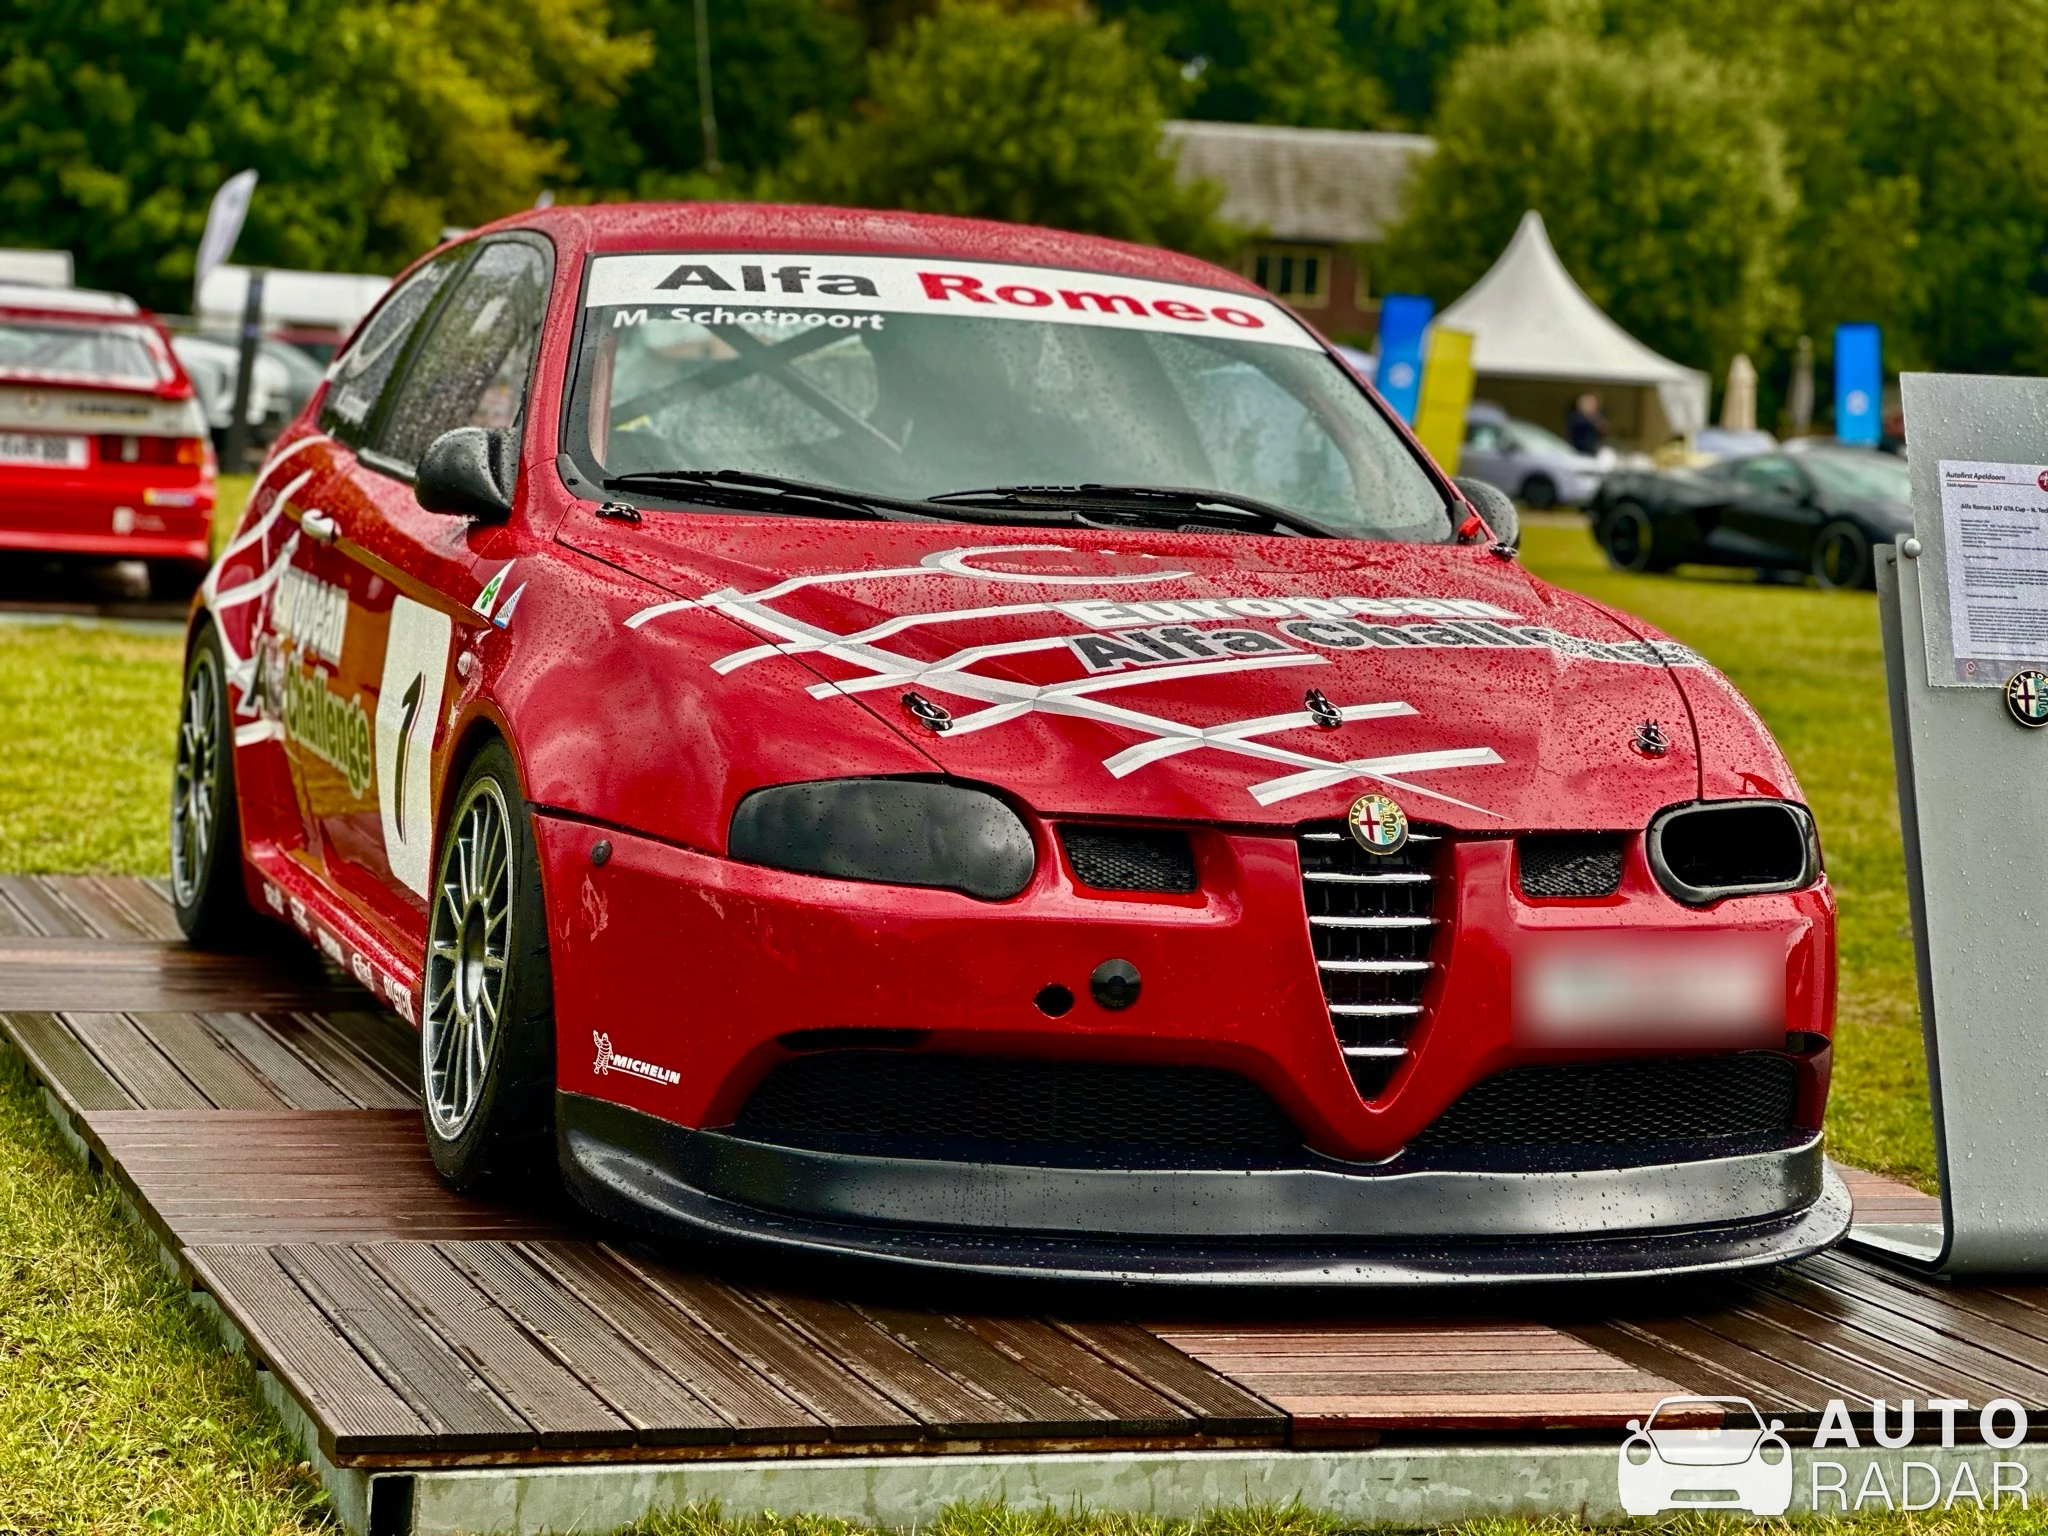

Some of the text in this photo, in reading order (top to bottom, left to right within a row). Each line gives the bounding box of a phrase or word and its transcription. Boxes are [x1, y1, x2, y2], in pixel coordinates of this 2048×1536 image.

[654, 264, 1265, 329] Alfa Romeo
[670, 307, 886, 331] Schotpoort
[1052, 598, 1524, 627] European
[1068, 625, 1294, 671] Alfa
[2010, 674, 2027, 699] ALFA
[284, 656, 370, 797] Challenge
[1352, 796, 1407, 826] ALFA ROMEO
[612, 1053, 681, 1085] MICHELIN
